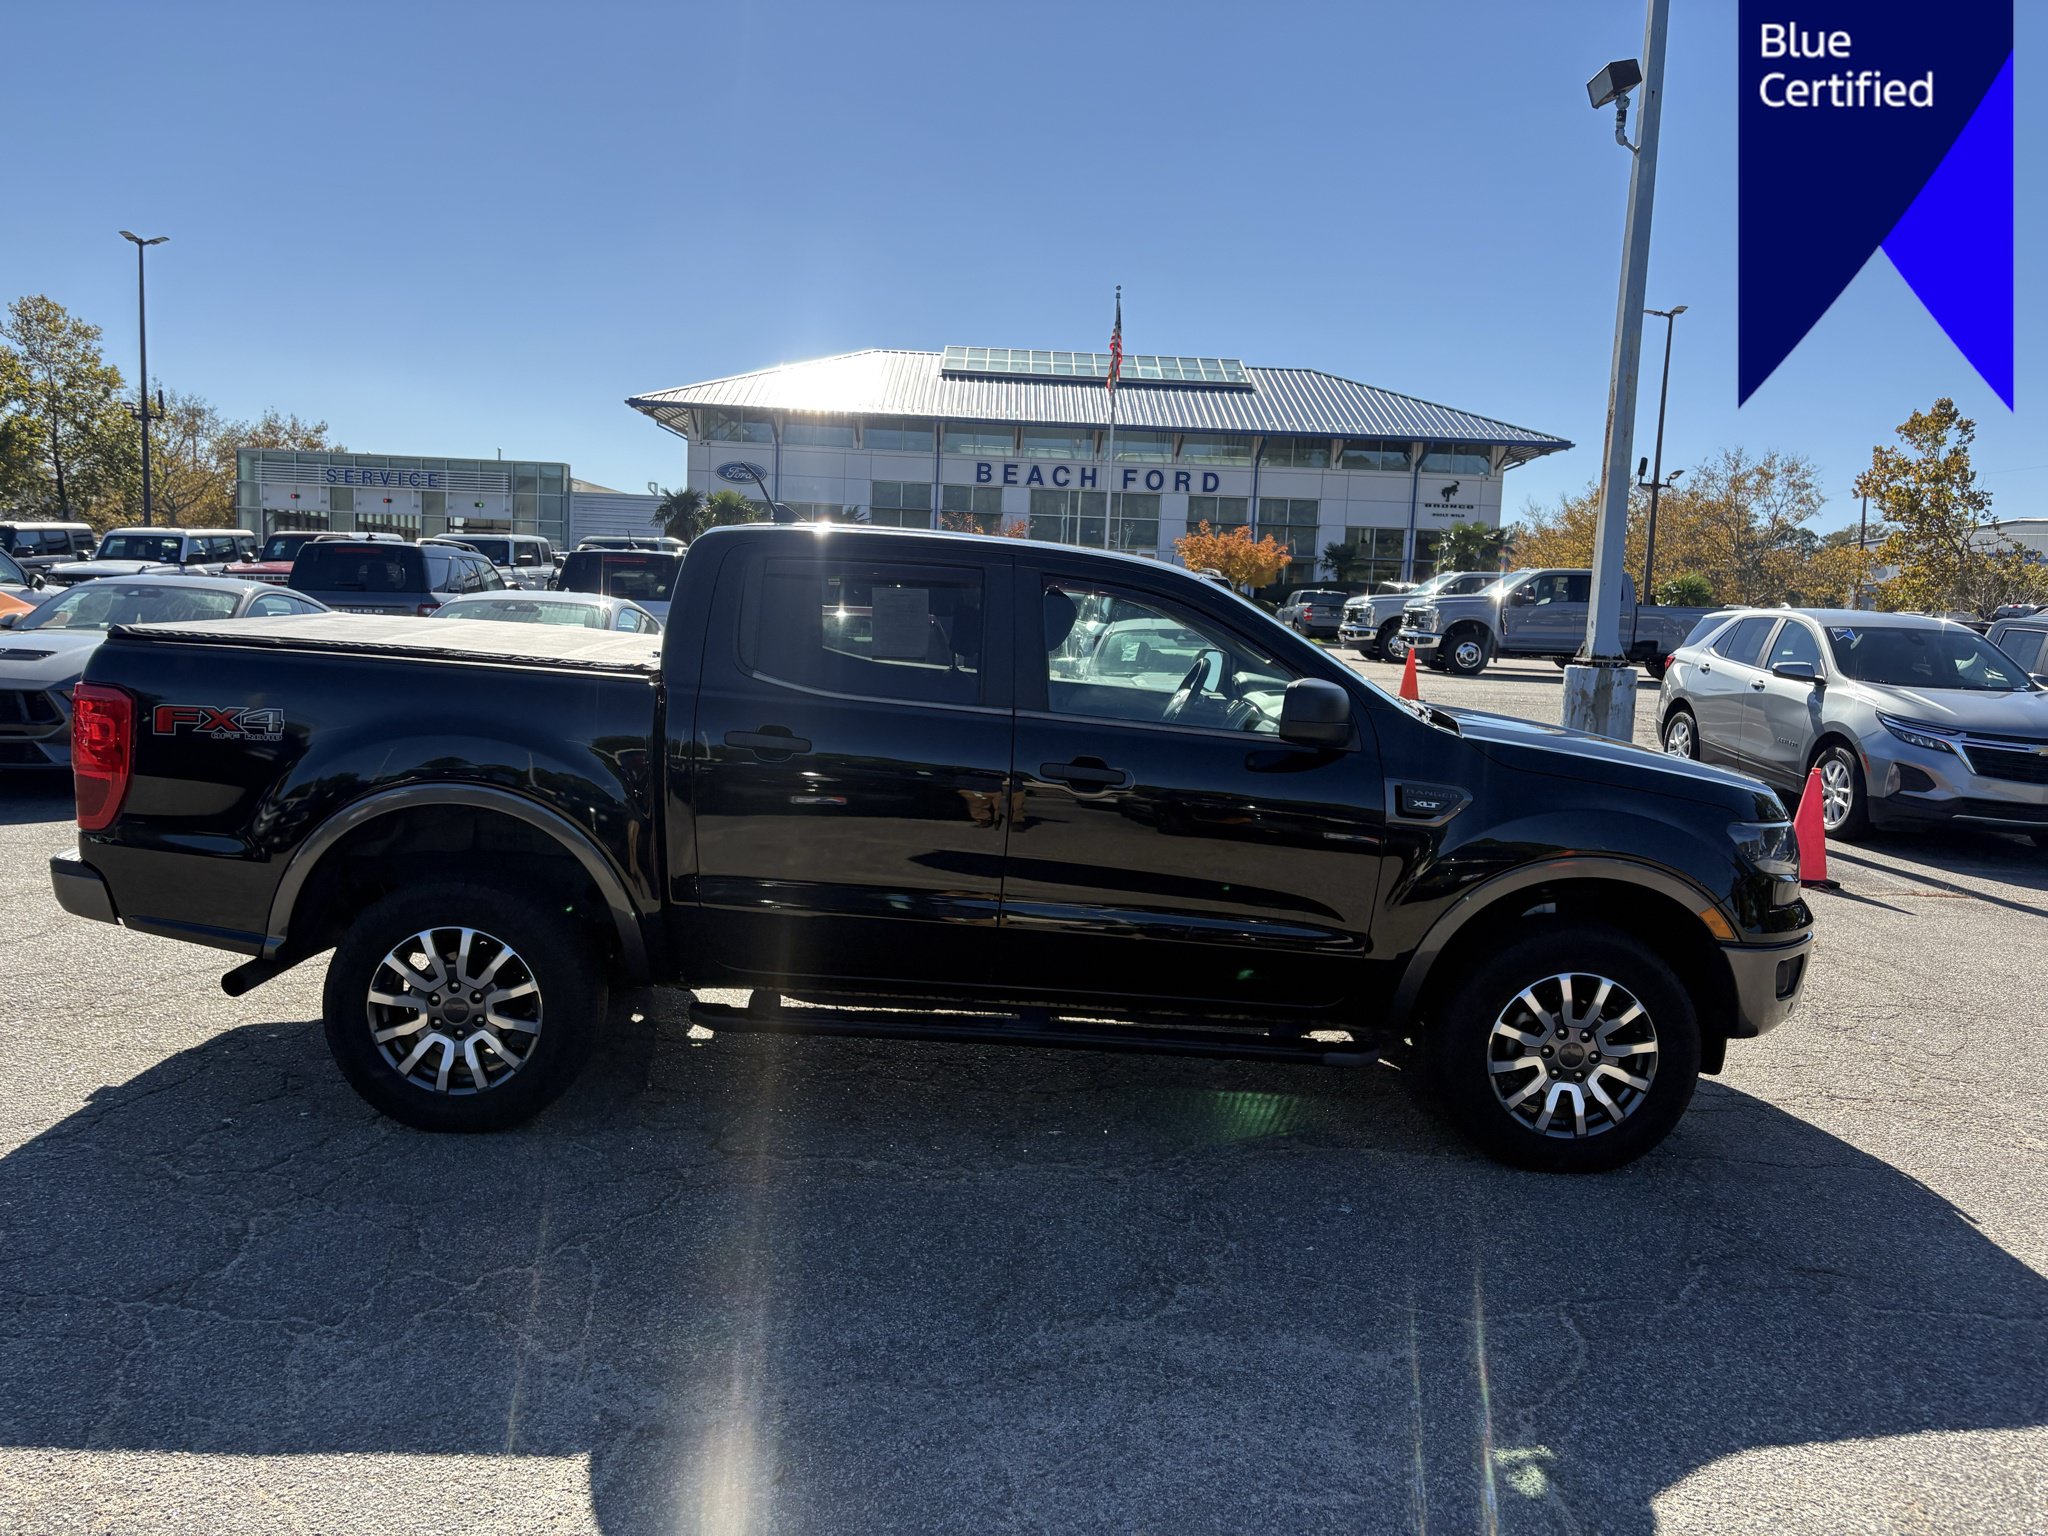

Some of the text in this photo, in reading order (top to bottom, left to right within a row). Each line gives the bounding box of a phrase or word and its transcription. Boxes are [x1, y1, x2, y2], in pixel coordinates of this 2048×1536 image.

[326, 469, 440, 488] SERVICE
[976, 462, 1220, 493] BEACH FORD
[153, 704, 285, 736] FX4
[1413, 800, 1440, 809] XLT
